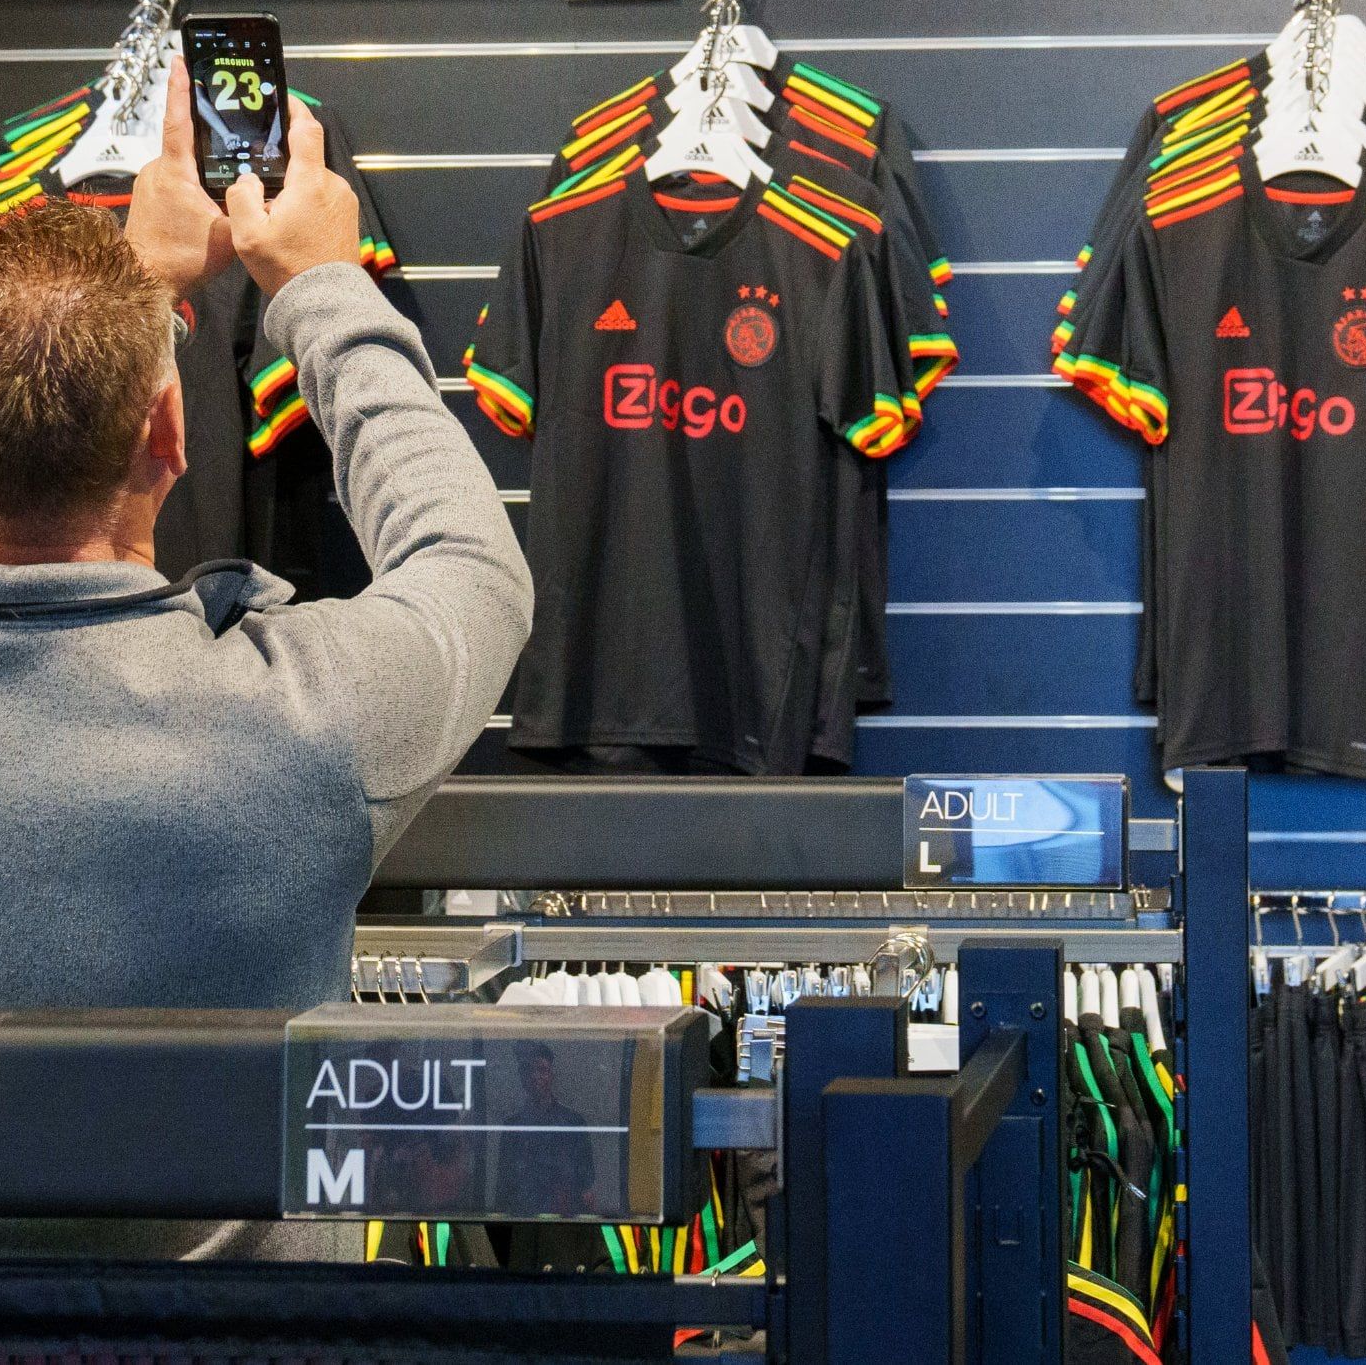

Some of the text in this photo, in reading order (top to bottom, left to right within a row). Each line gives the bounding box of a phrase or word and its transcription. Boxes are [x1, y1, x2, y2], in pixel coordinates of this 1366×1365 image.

[211, 70, 264, 111] 23
[920, 791, 1024, 821] ADULT
[919, 841, 942, 873] L
[305, 1059, 486, 1111] ADULT
[306, 1148, 365, 1205] M
